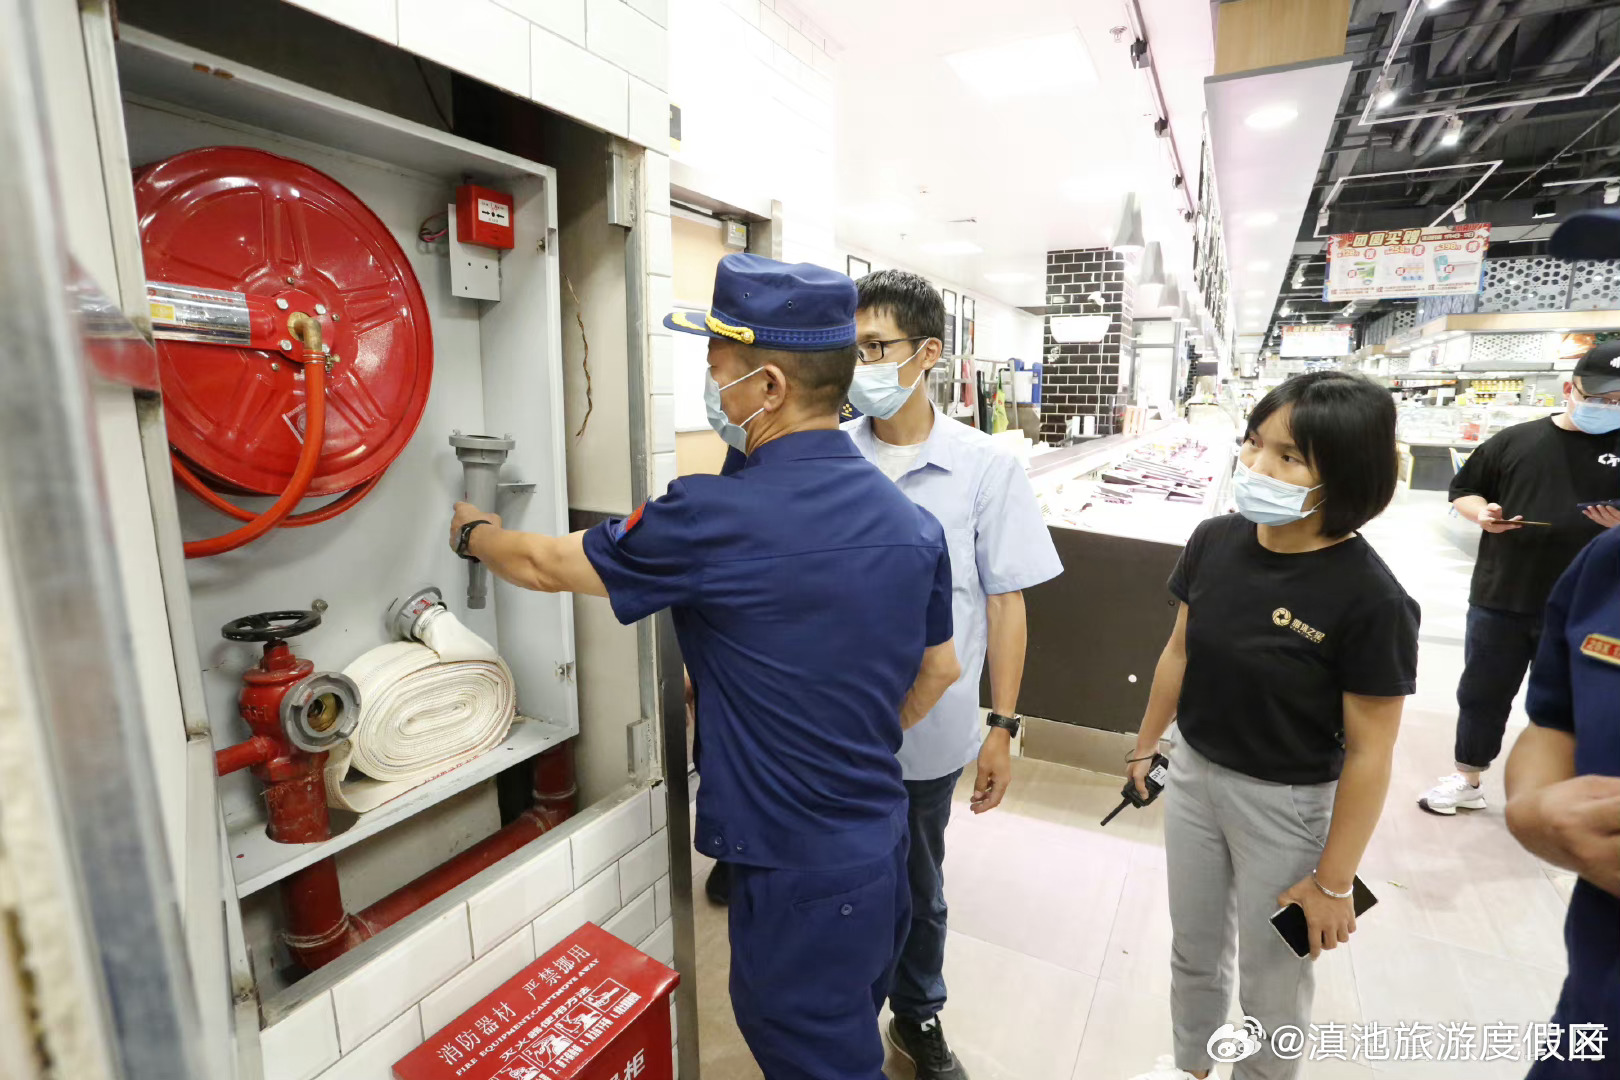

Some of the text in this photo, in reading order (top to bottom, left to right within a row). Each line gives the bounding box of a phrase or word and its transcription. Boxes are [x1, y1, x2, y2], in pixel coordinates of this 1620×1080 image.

[1352, 229, 1421, 248] 团圆买赠
[436, 1001, 518, 1065] 消防器材
[521, 944, 591, 1000] 严禁挪用
[455, 1058, 478, 1077] FIRE
[578, 958, 599, 977] AWAY
[499, 986, 592, 1062] 灭火器使用方法
